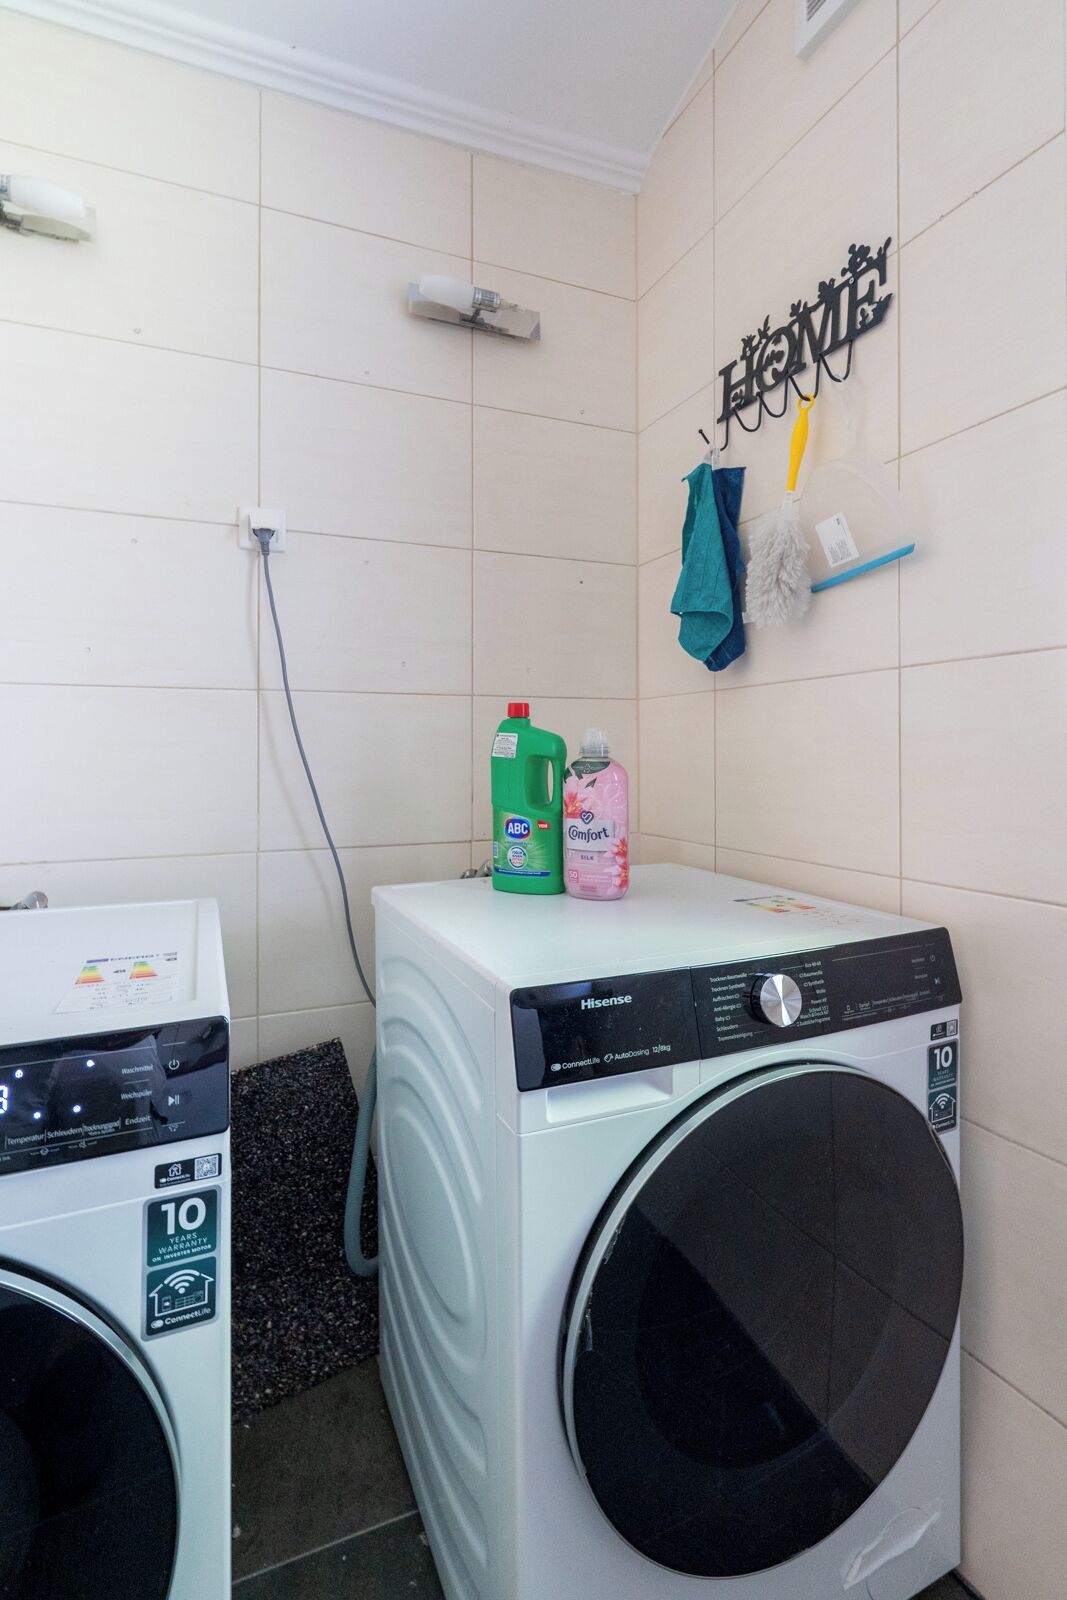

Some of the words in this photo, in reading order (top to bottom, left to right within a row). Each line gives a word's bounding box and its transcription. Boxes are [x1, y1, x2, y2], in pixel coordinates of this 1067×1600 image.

[717, 238, 893, 424] HOME
[507, 822, 528, 835] ABC
[568, 825, 610, 843] Comfort
[581, 994, 632, 1010] Hisense
[562, 1056, 600, 1070] ConnectLife
[614, 1048, 650, 1060] AutoDosing
[652, 1044, 671, 1054] 12/8kg
[934, 1046, 952, 1070] 10
[122, 1064, 154, 1074] Waschmittel
[8, 1134, 44, 1145] Temperatur
[48, 1127, 82, 1139] Schleudern
[125, 1115, 151, 1126] Endzeit
[160, 1197, 206, 1236] 10
[159, 1237, 208, 1254] WARRANTY
[170, 1232, 198, 1244] YEARS
[164, 1250, 190, 1260] INVERTER
[192, 1244, 212, 1252] MOTOR
[164, 1307, 212, 1326] ConnectLife
